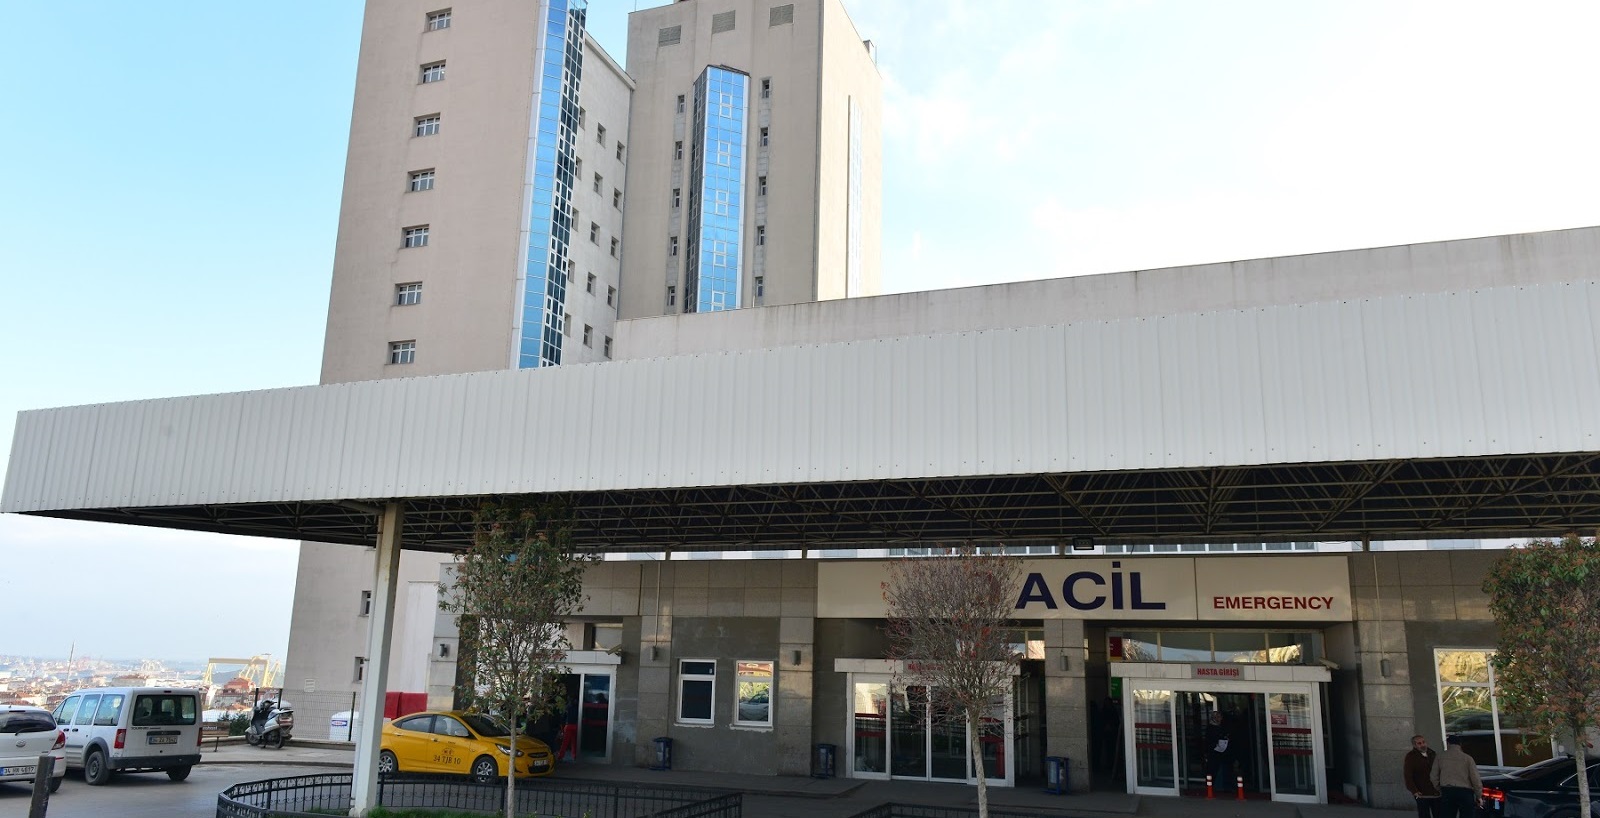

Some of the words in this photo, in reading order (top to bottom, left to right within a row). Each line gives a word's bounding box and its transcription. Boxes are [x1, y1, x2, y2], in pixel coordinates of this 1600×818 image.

[1014, 560, 1166, 610] ACİL
[1213, 596, 1334, 610] EMERGENCY
[1197, 667, 1218, 676] HASTA
[442, 755, 452, 764] TJB
[454, 757, 461, 765] 10
